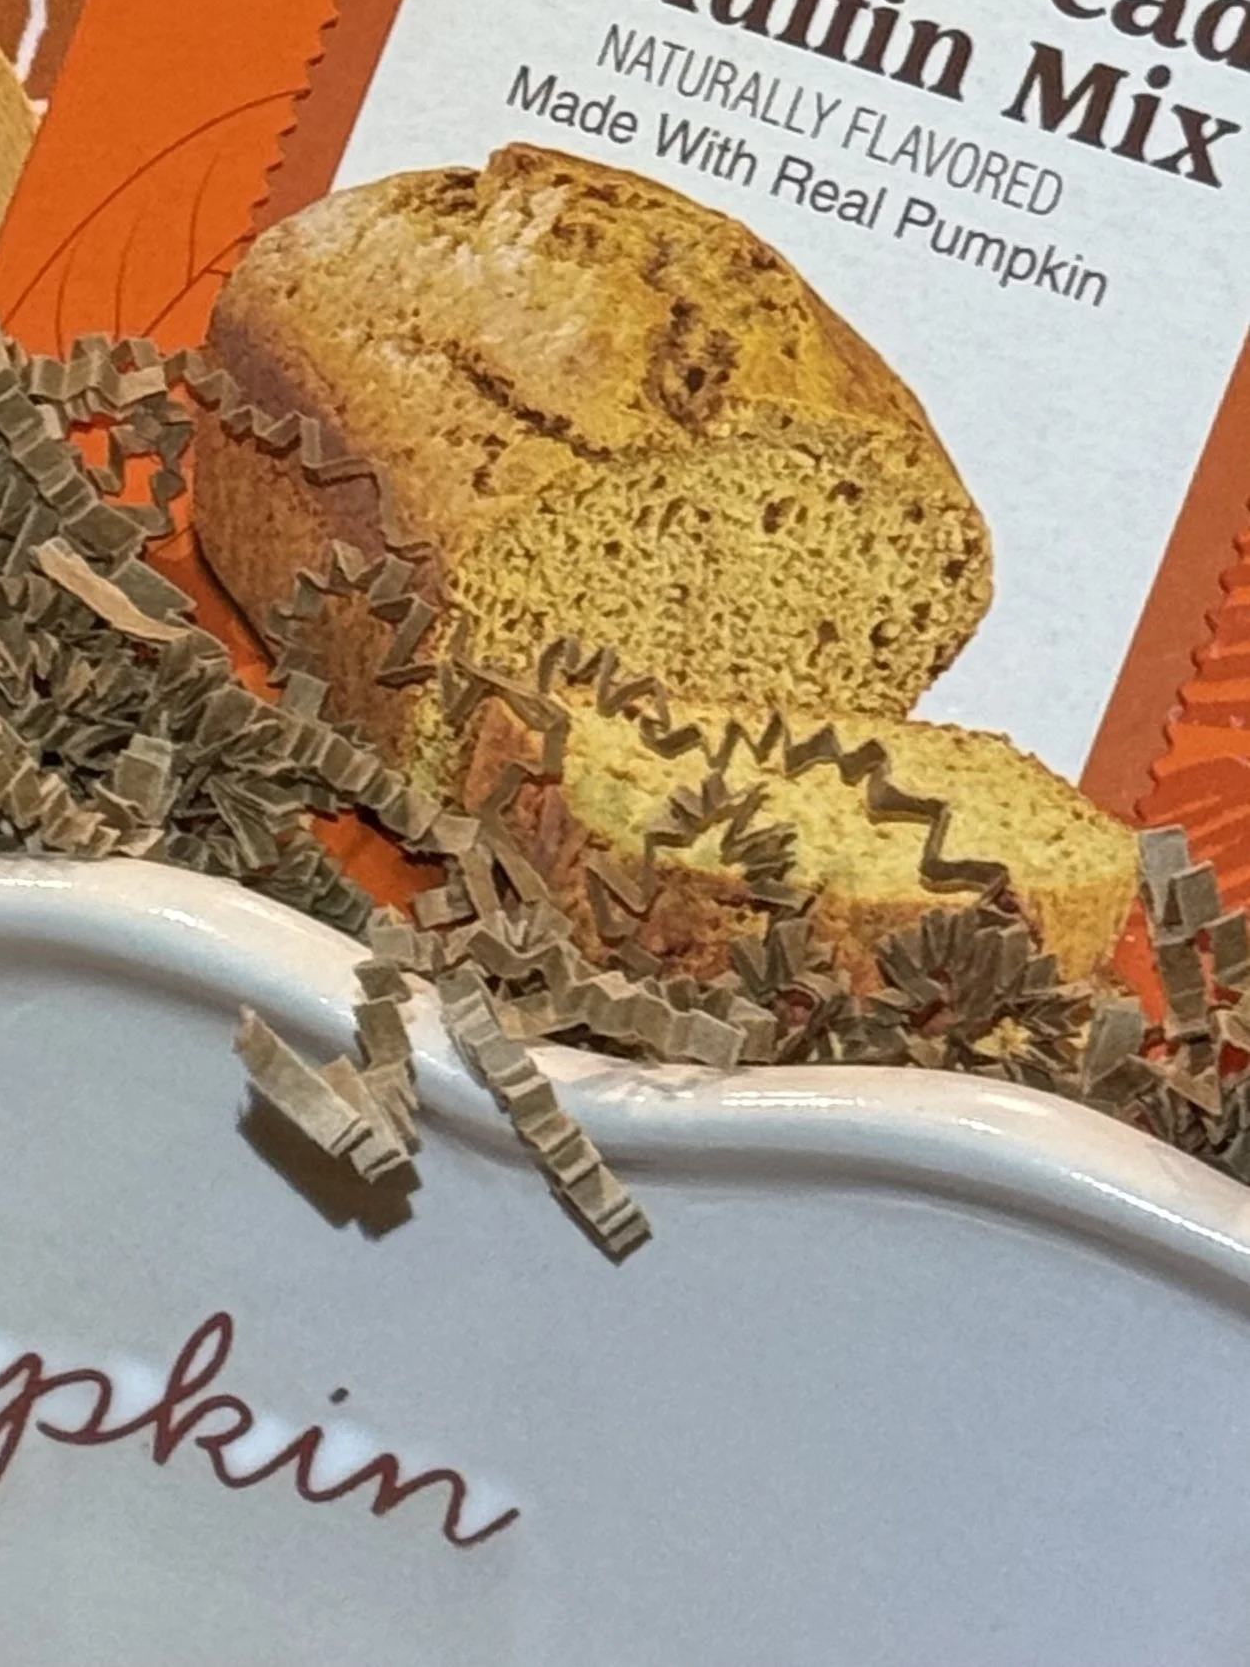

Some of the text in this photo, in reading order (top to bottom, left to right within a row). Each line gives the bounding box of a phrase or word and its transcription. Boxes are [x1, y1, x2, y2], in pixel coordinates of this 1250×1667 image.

[506, 65, 1108, 308] Made With Real Pumpkin
[597, 24, 1064, 217] NATURALLY FLAVORED
[1000, 40, 1242, 189] Mix
